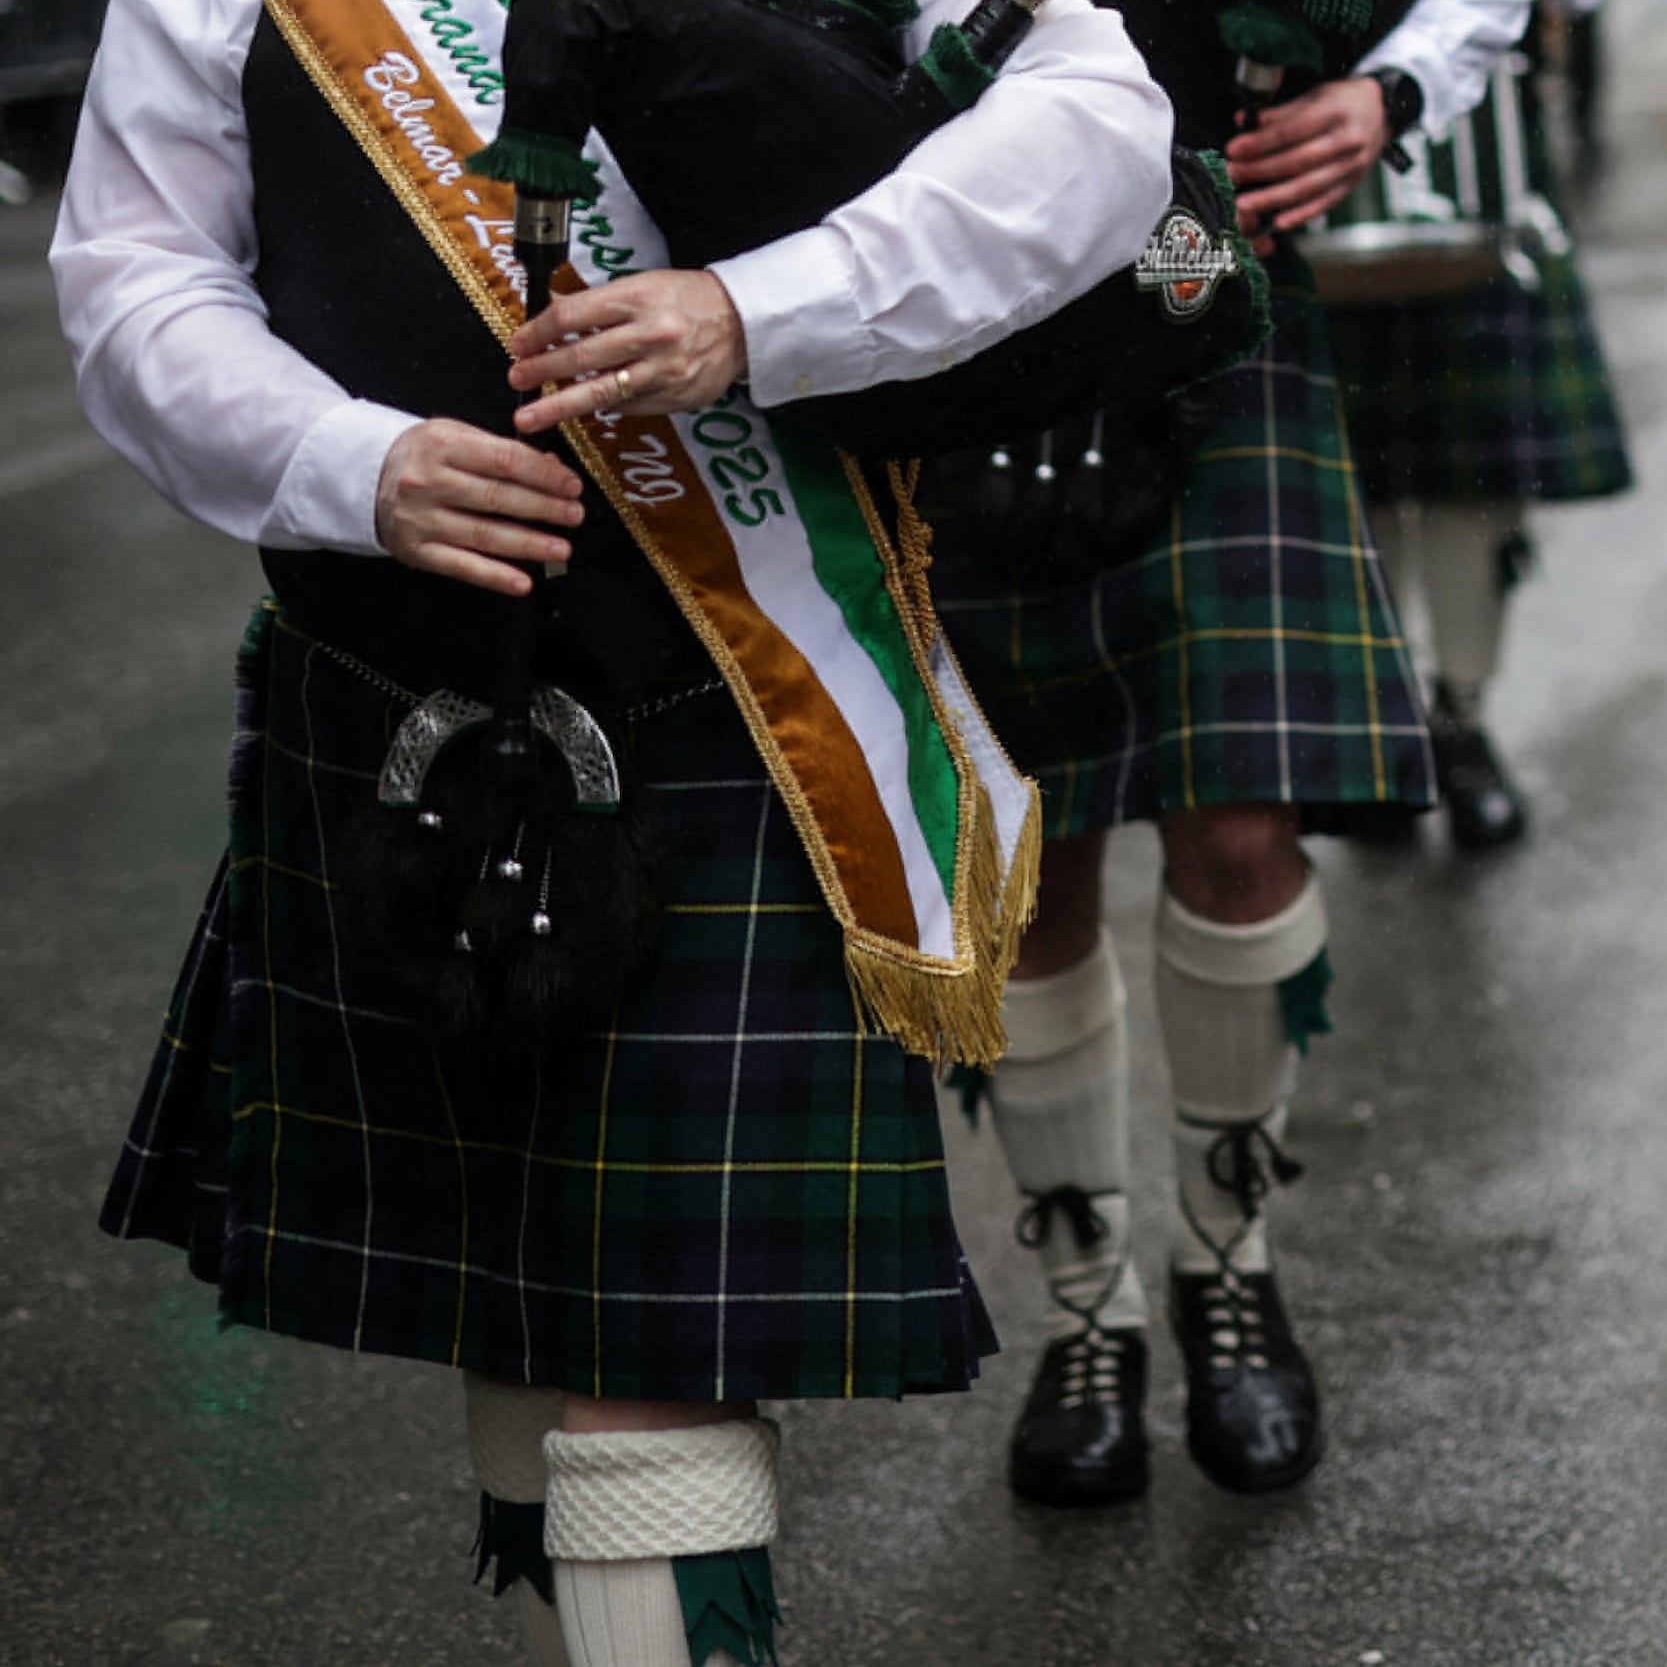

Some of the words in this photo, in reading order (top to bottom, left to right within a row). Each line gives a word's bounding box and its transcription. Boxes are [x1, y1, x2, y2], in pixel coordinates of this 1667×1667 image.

[364, 50, 463, 186] Belmar
[619, 434, 686, 506] NJ
[688, 387, 786, 526] 025
